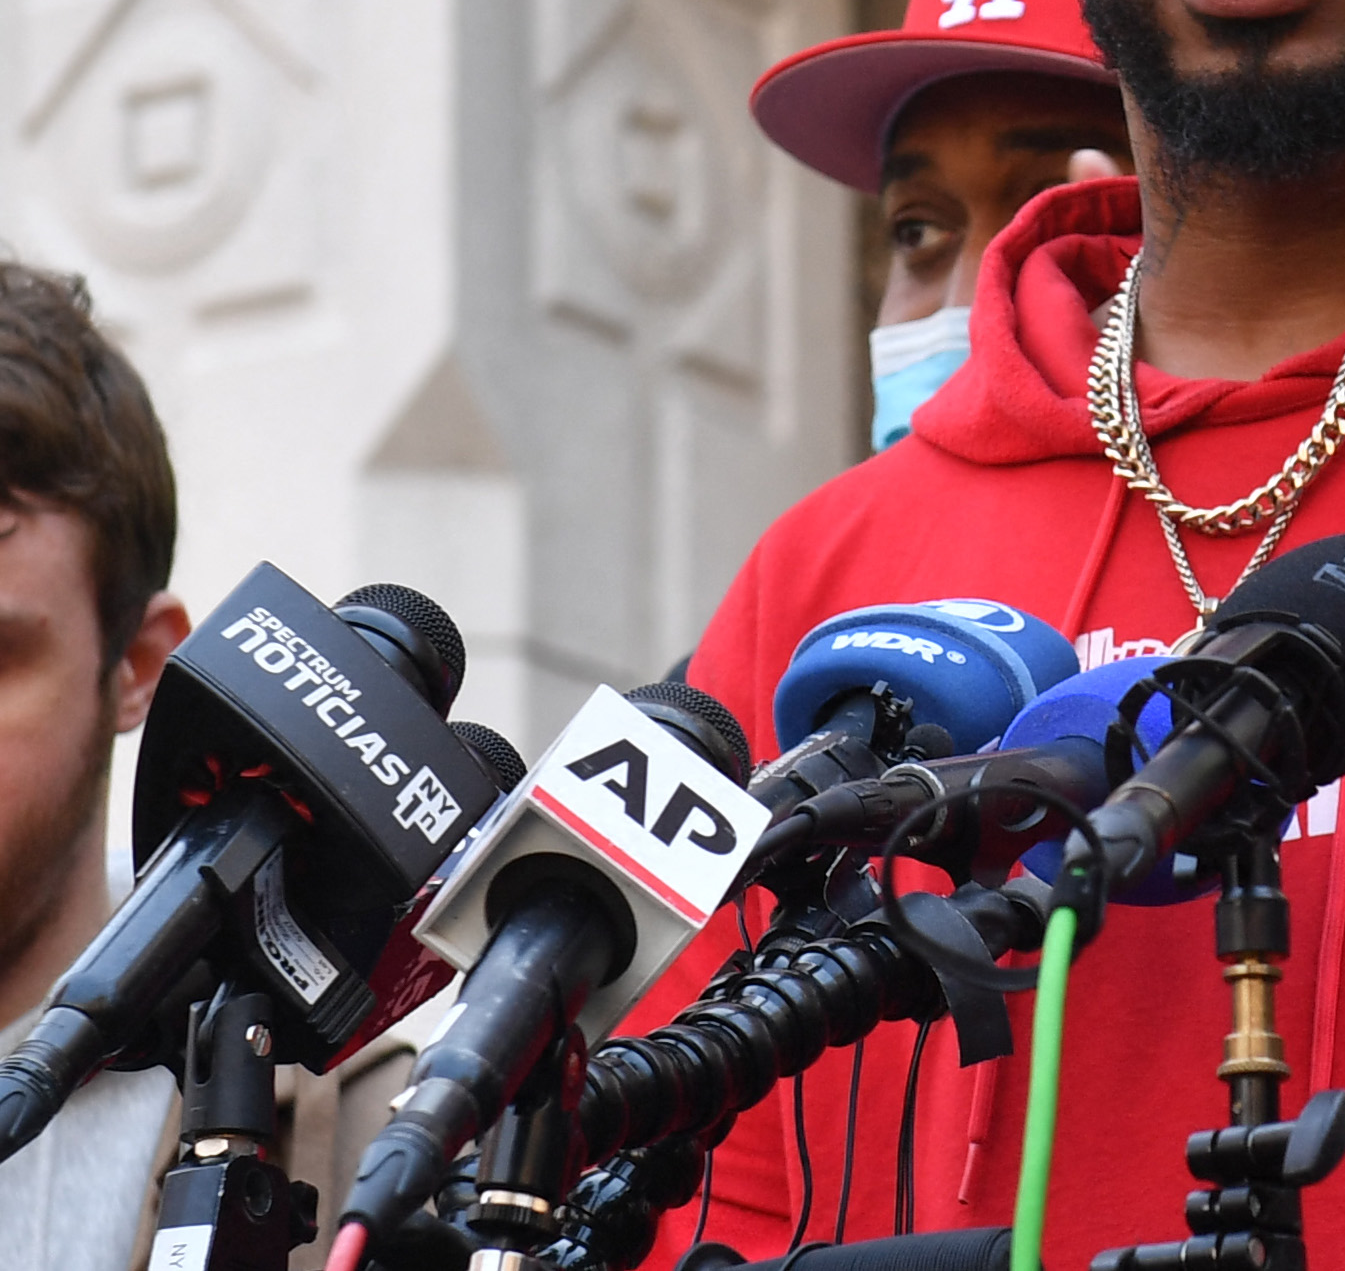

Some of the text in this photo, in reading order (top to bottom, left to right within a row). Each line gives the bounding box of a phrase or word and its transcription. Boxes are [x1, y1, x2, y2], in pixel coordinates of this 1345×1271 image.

[247, 606, 362, 702] SPECTRUM
[831, 631, 945, 664] WDR
[419, 776, 455, 817] NY
[564, 738, 738, 856] AP
